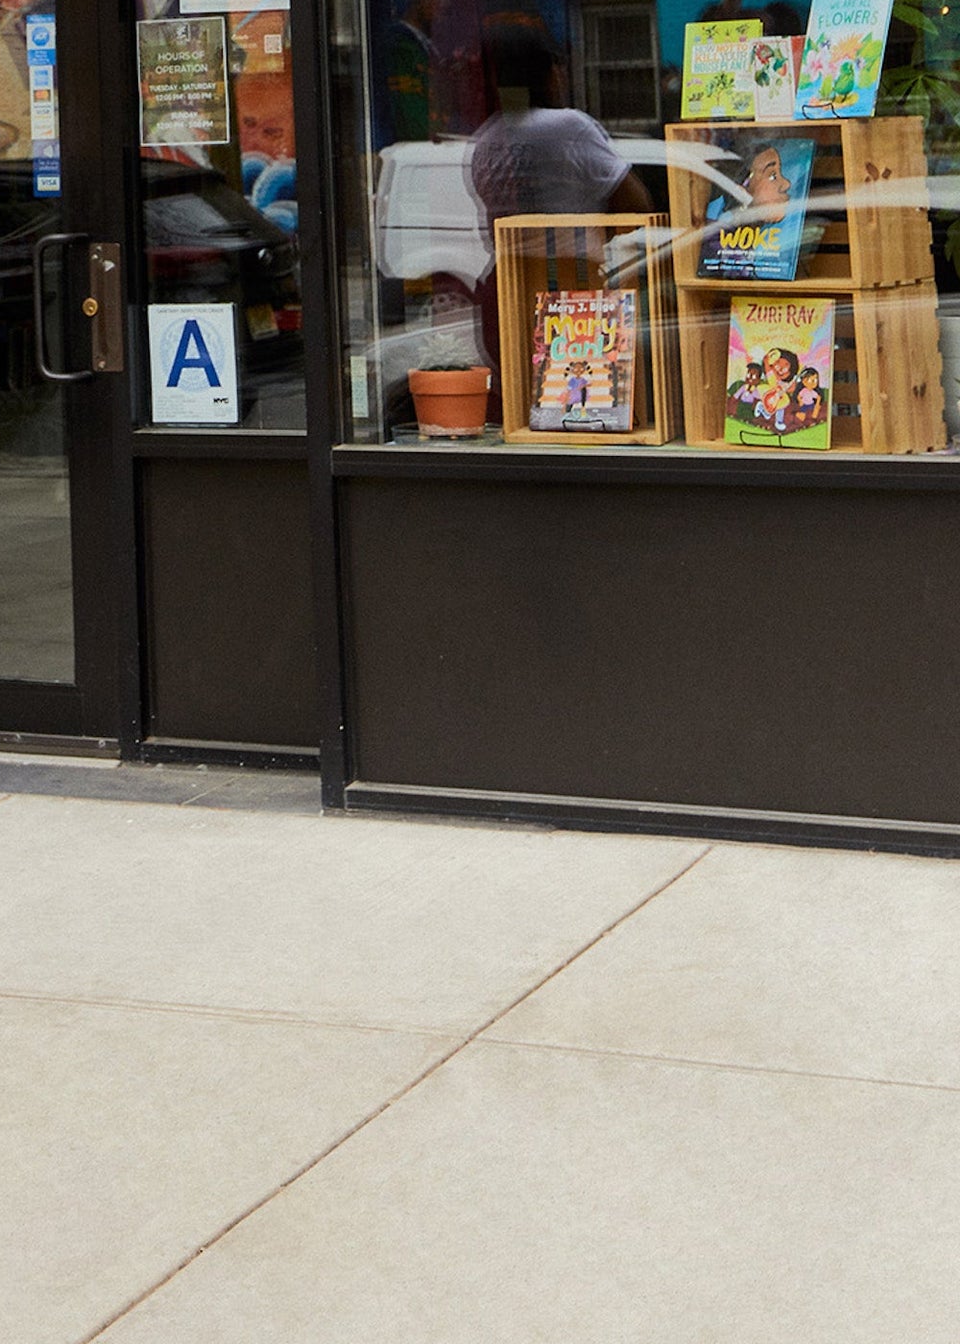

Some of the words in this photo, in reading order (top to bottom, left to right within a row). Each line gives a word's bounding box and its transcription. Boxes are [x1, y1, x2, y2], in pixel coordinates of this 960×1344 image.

[843, 0, 856, 7] ARE
[818, 10, 879, 29] FLOWERS
[158, 51, 190, 61] HOURS
[191, 50, 205, 59] OF
[155, 64, 208, 74] OPERATION
[149, 84, 178, 92] TUESDAY
[182, 83, 216, 91] SATURDAY
[720, 226, 781, 250] WOKE
[548, 303, 575, 314] Mary
[578, 303, 587, 312] J.
[786, 303, 815, 328] RAY
[544, 315, 618, 353] Mary
[166, 319, 221, 387] A
